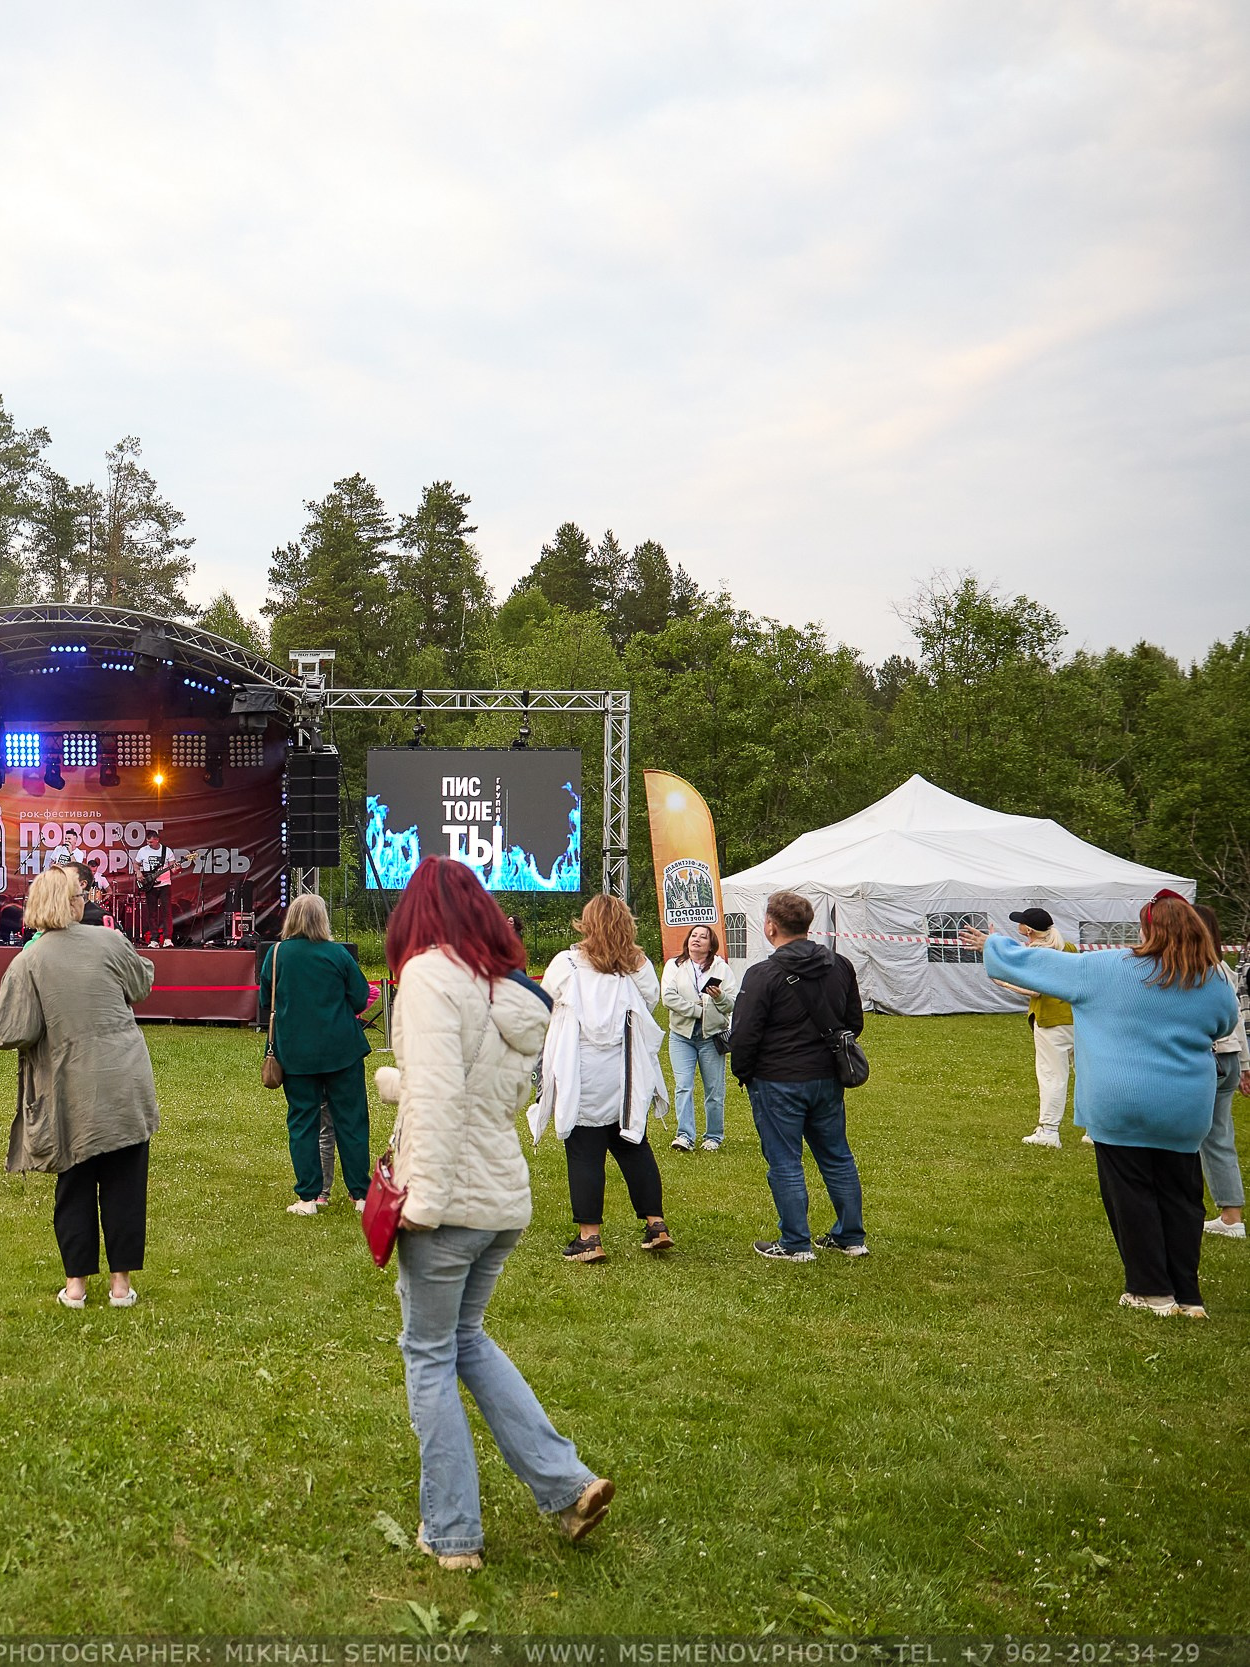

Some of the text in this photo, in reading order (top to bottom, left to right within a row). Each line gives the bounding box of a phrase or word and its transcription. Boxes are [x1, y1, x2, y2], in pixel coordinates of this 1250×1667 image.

[442, 777, 481, 797] ПИС
[20, 809, 102, 820] рок-фестиваль
[442, 801, 493, 821] ТОЛЕ
[442, 825, 502, 866] ТЫ
